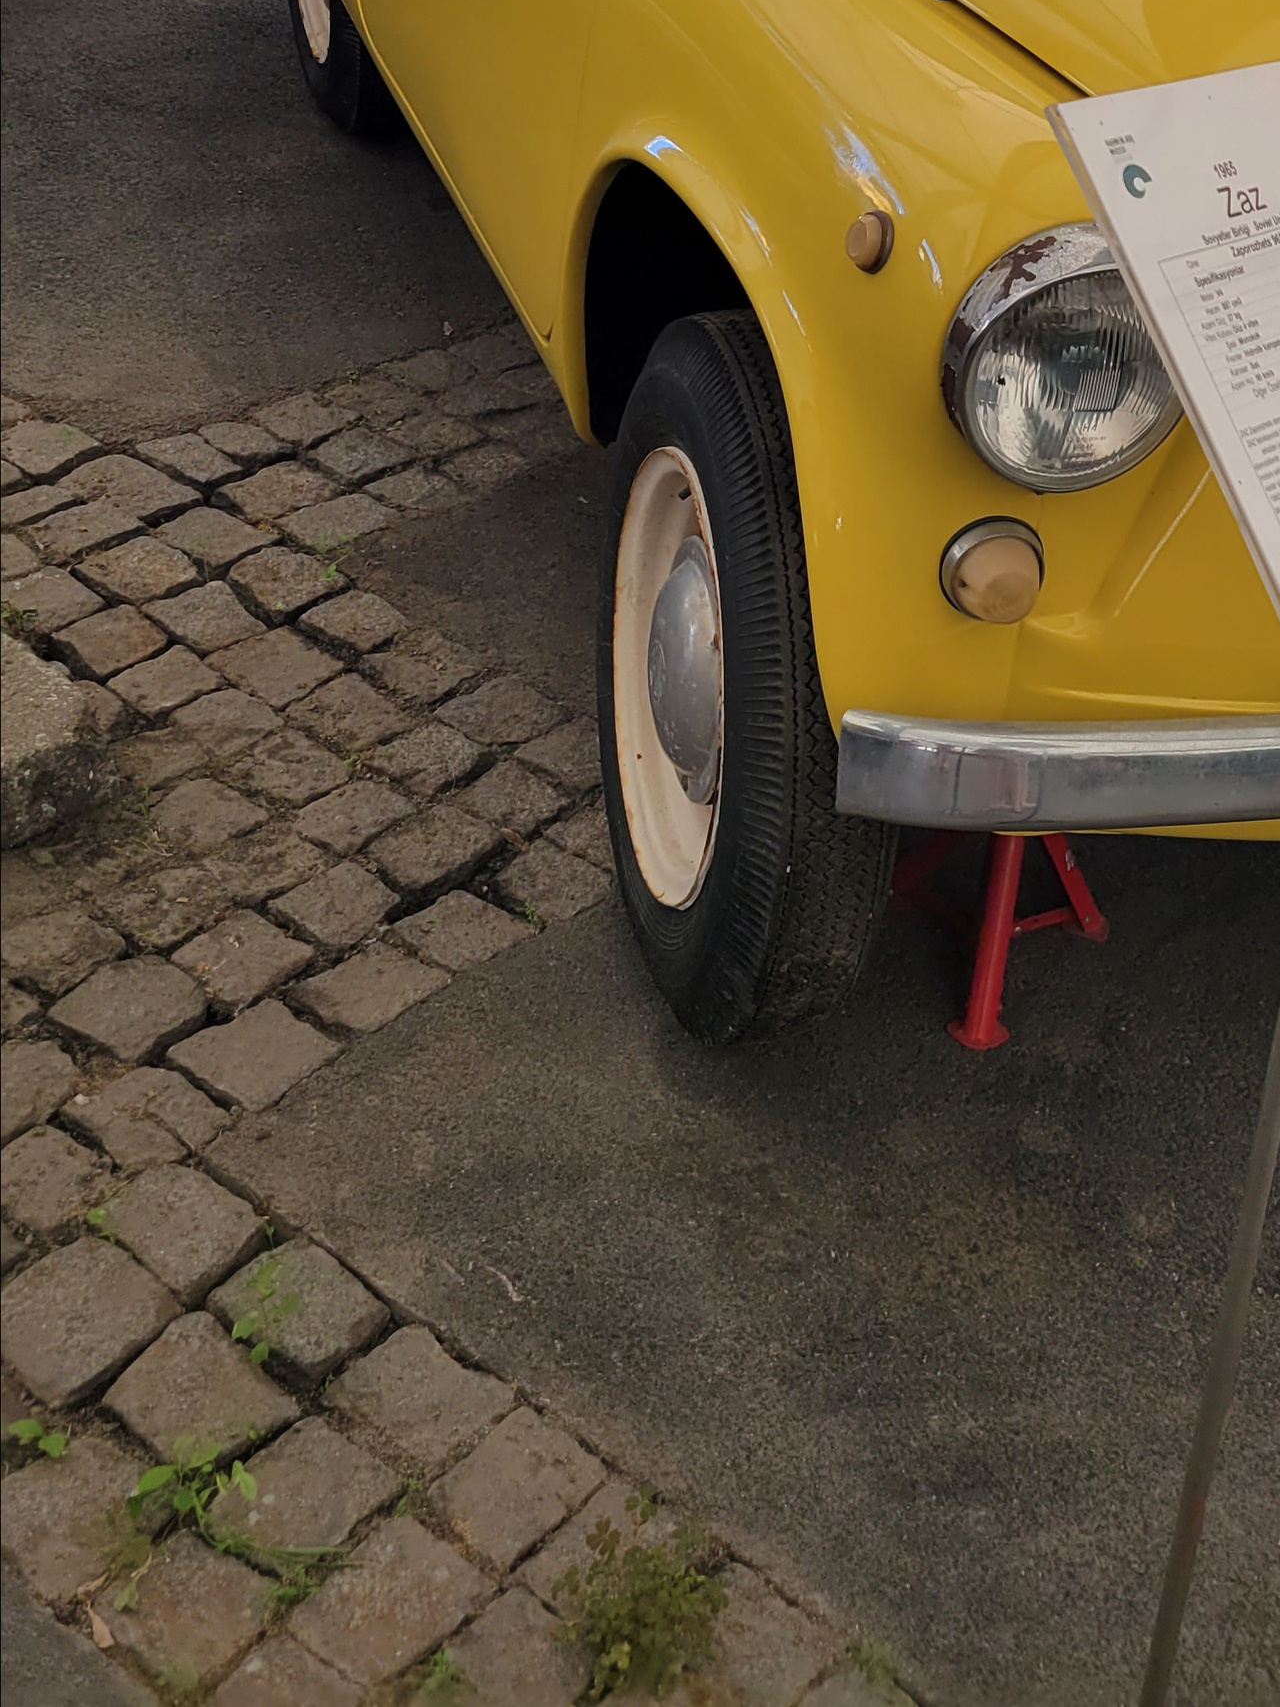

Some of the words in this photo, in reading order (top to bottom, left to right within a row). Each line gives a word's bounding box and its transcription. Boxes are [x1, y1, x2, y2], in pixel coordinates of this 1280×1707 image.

[1213, 160, 1238, 179] 1965
[1216, 186, 1267, 219] Zaz
[1230, 236, 1273, 258] Zaporozhets
